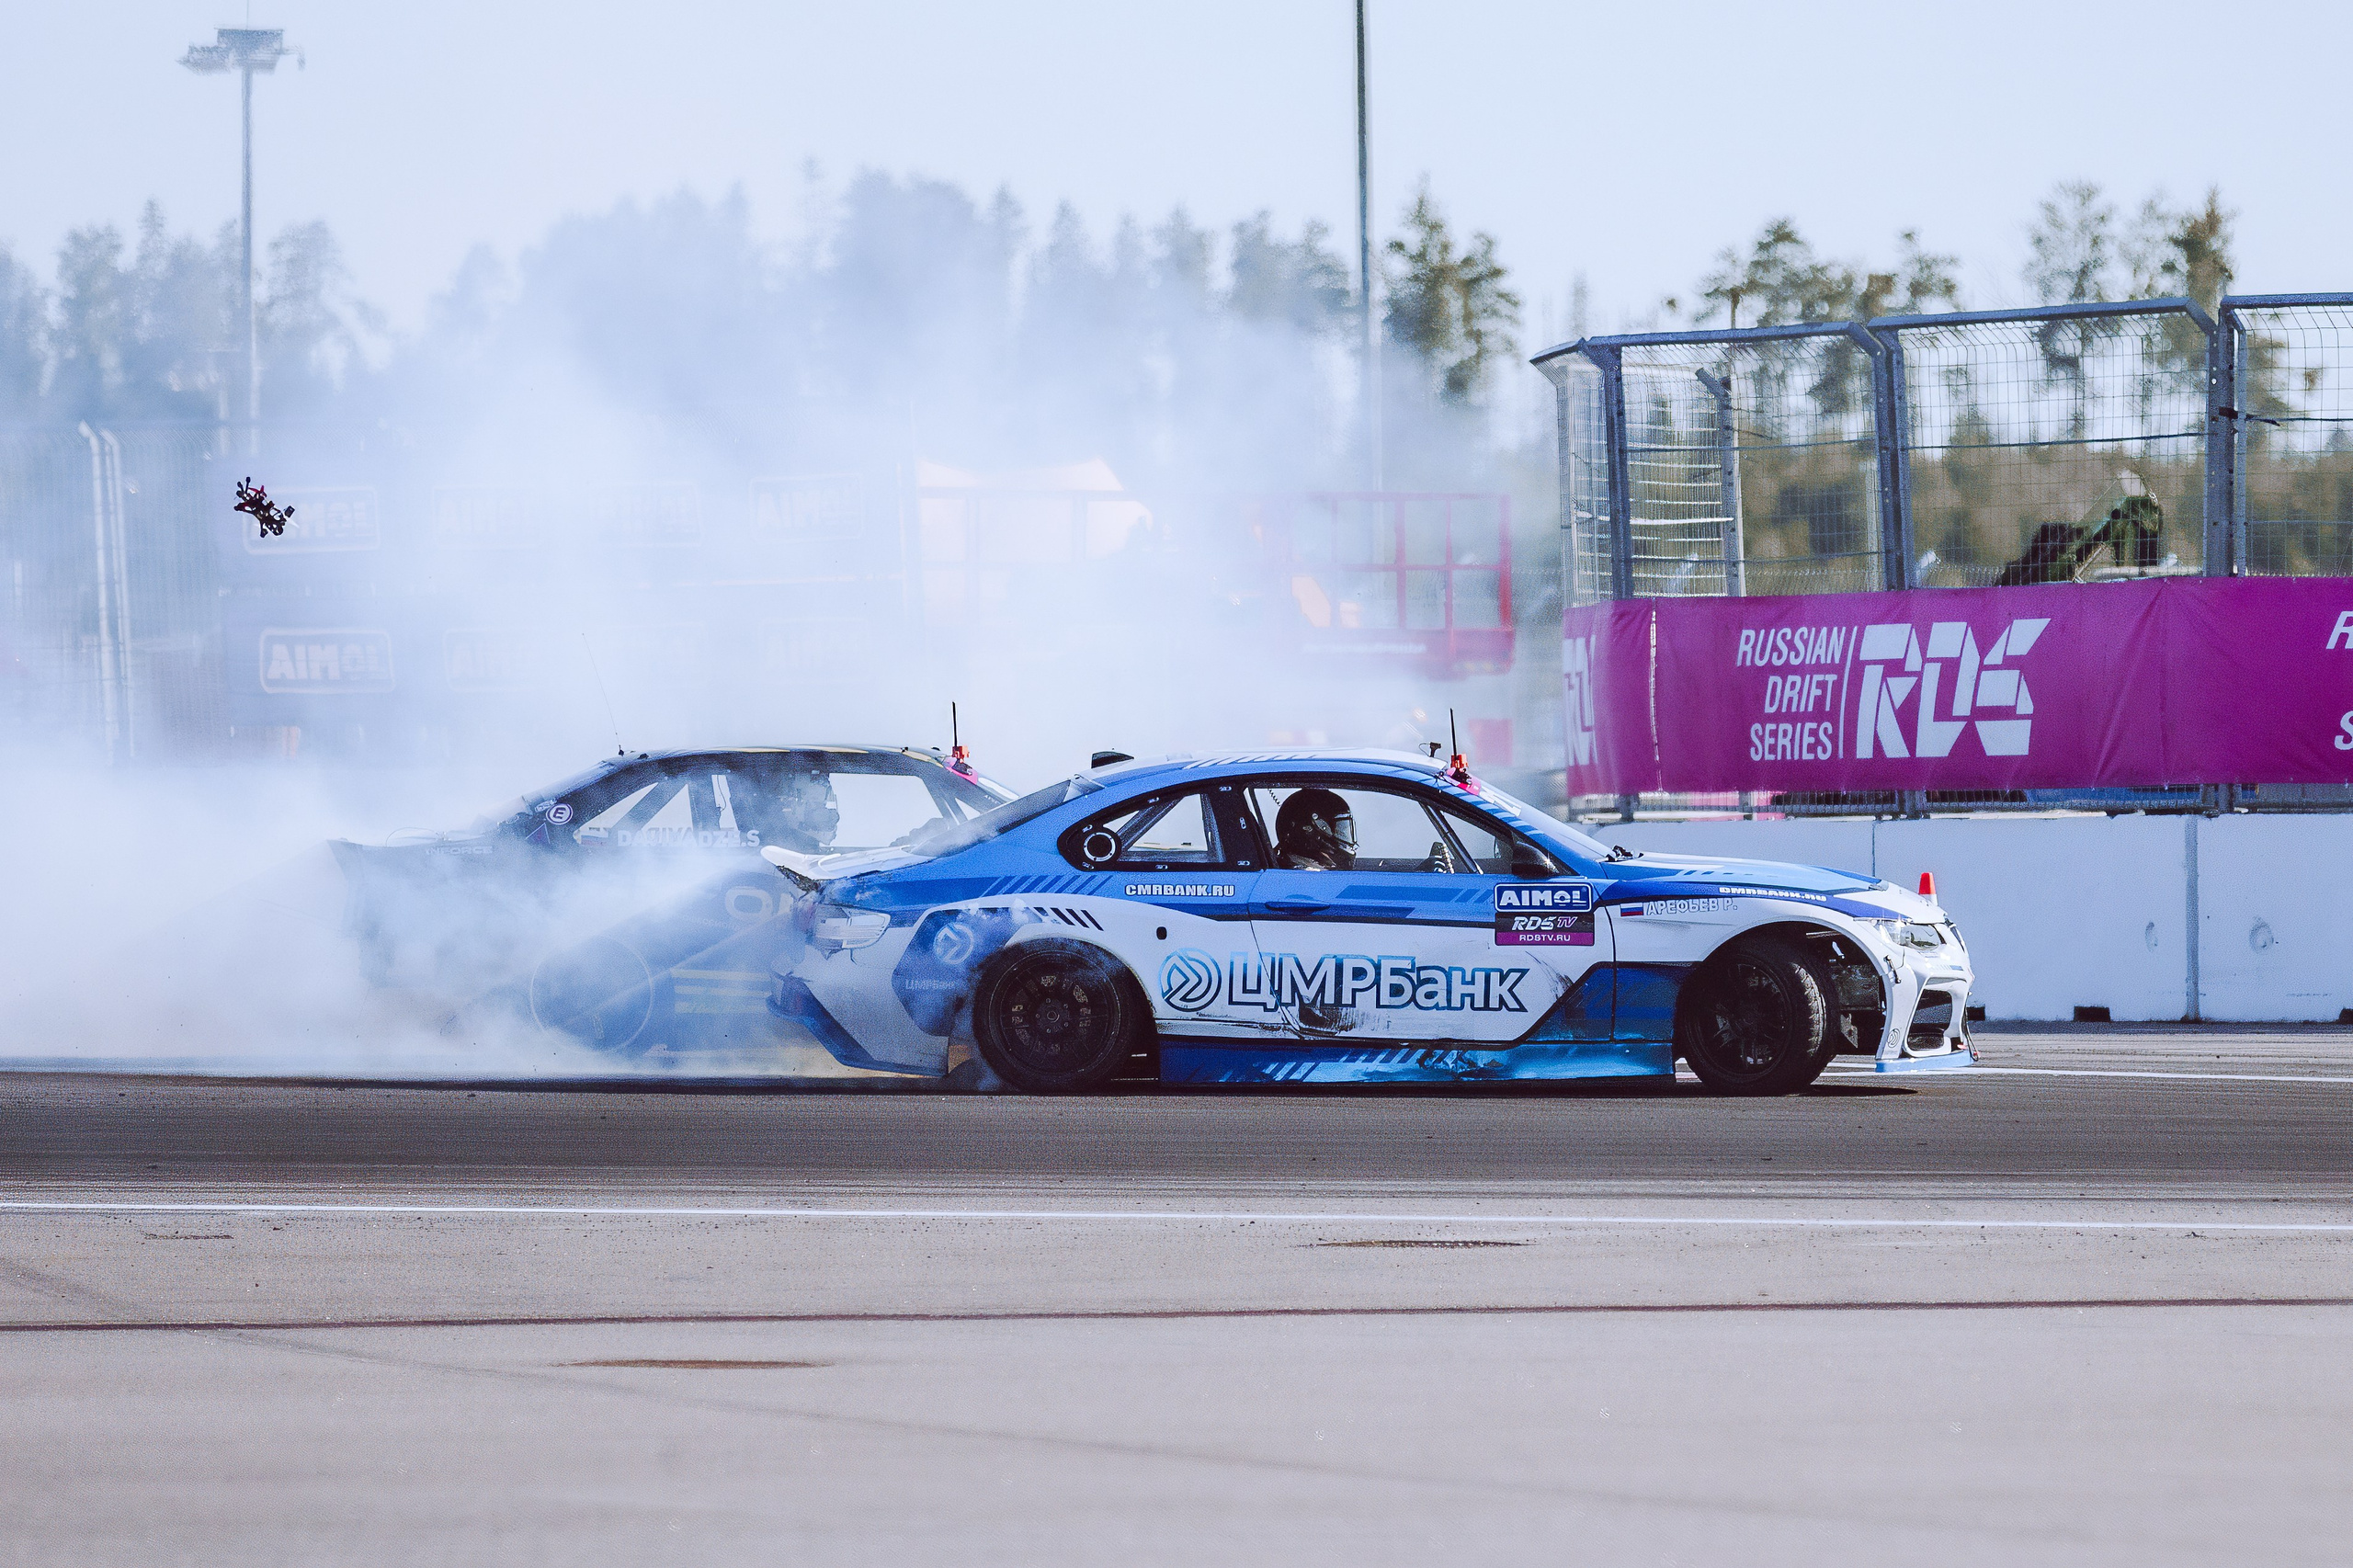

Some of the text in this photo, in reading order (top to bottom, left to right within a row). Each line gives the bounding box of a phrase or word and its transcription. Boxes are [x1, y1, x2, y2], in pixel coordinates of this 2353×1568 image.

[267, 643, 388, 680] AIMOL
[1736, 626, 1846, 667] RUSSIAN
[1765, 674, 1837, 713] DRIFT
[1857, 618, 2052, 758] RDS
[1750, 722, 1833, 761] SERIES
[1125, 884, 1234, 897] CMRBANK.RU
[1499, 890, 1587, 907] AIMOL
[1519, 934, 1571, 942] RDSTV.RU
[1228, 950, 1530, 1012] ЦМРБанк
